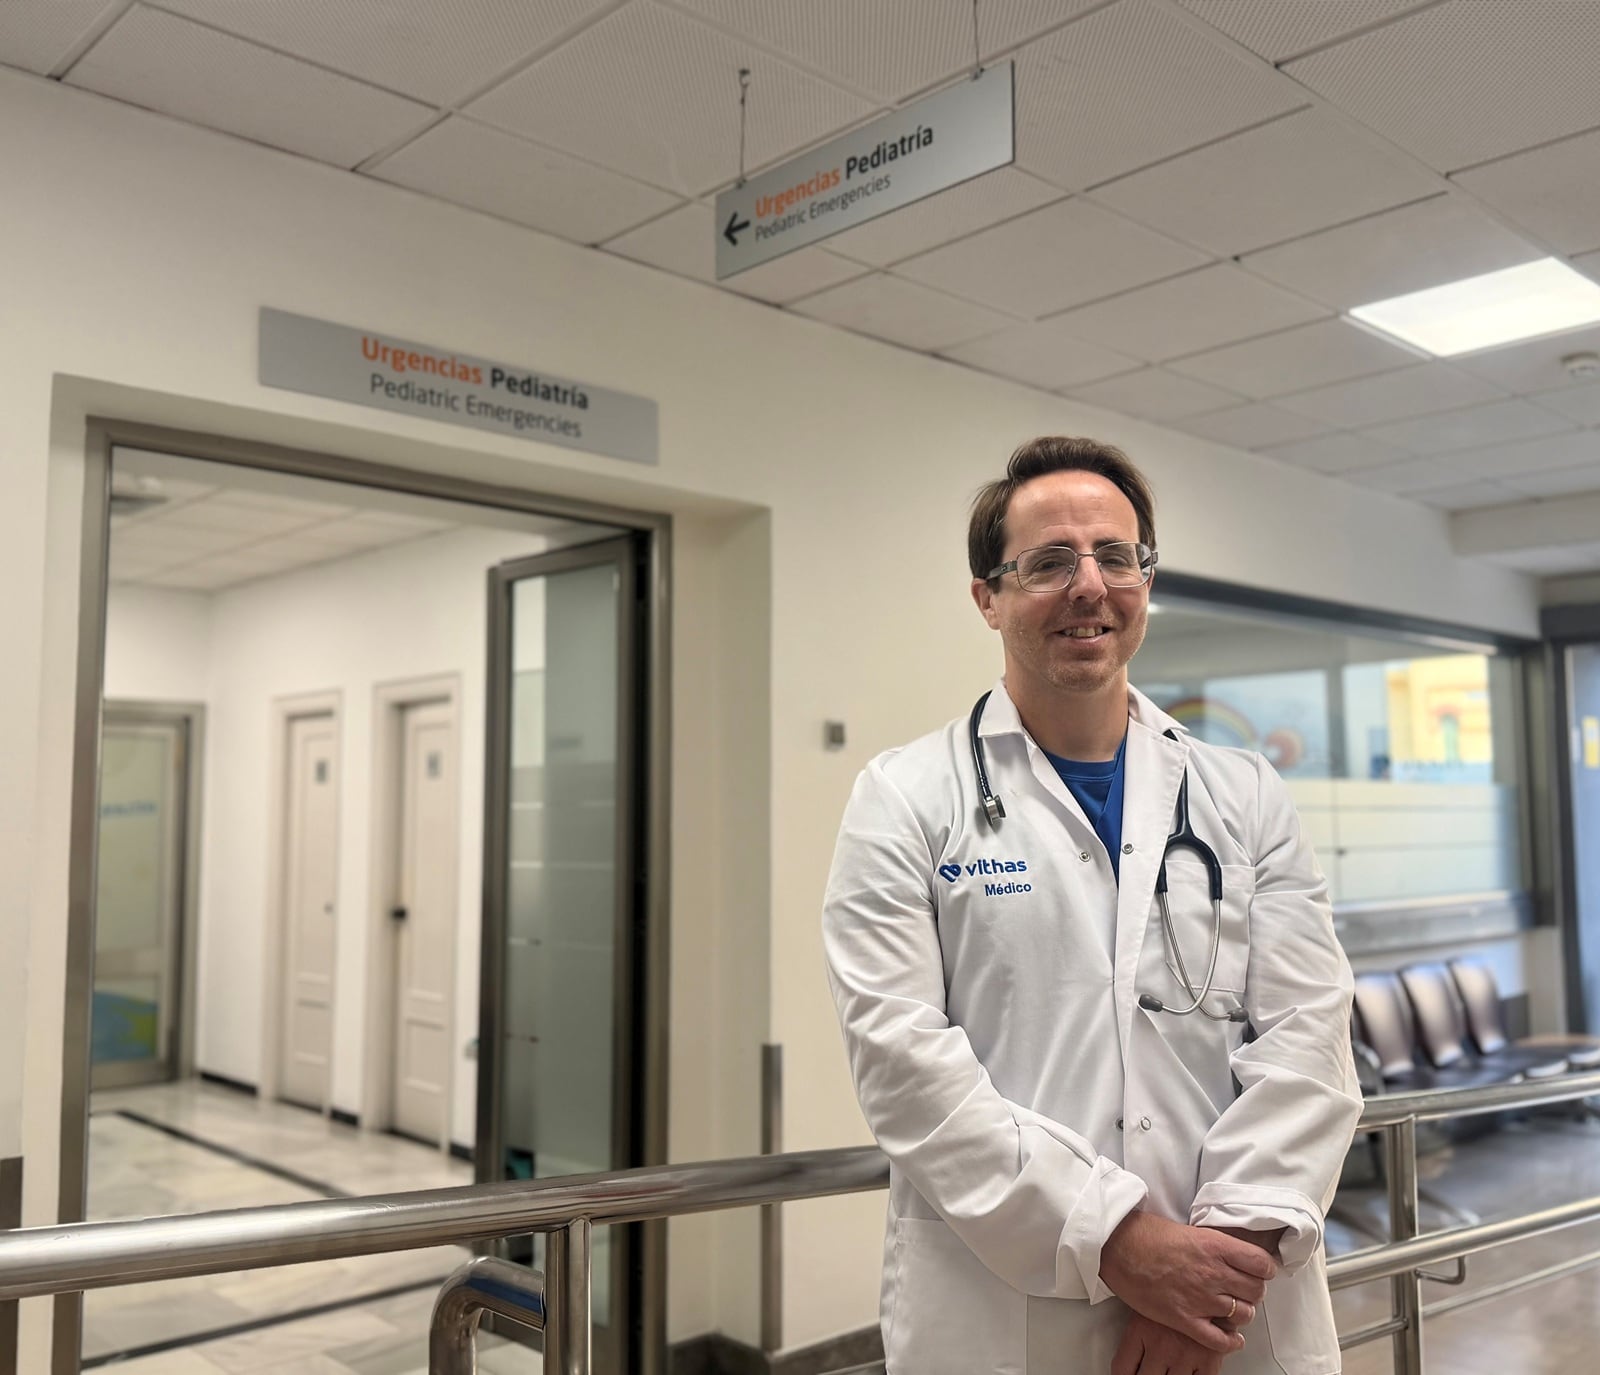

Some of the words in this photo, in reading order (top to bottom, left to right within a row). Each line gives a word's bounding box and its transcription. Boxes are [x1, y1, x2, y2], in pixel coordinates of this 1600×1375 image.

[755, 167, 840, 219] Urgencias
[846, 125, 934, 179] Pediatría
[755, 211, 806, 242] Pediatric
[809, 174, 891, 220] Emergencies
[362, 336, 483, 385] Urgencias
[490, 367, 589, 410] Pediatría
[370, 373, 460, 412] Pediatric
[466, 395, 582, 438] Emergencies
[965, 859, 1027, 876] vithas
[984, 882, 1032, 896] Médico
